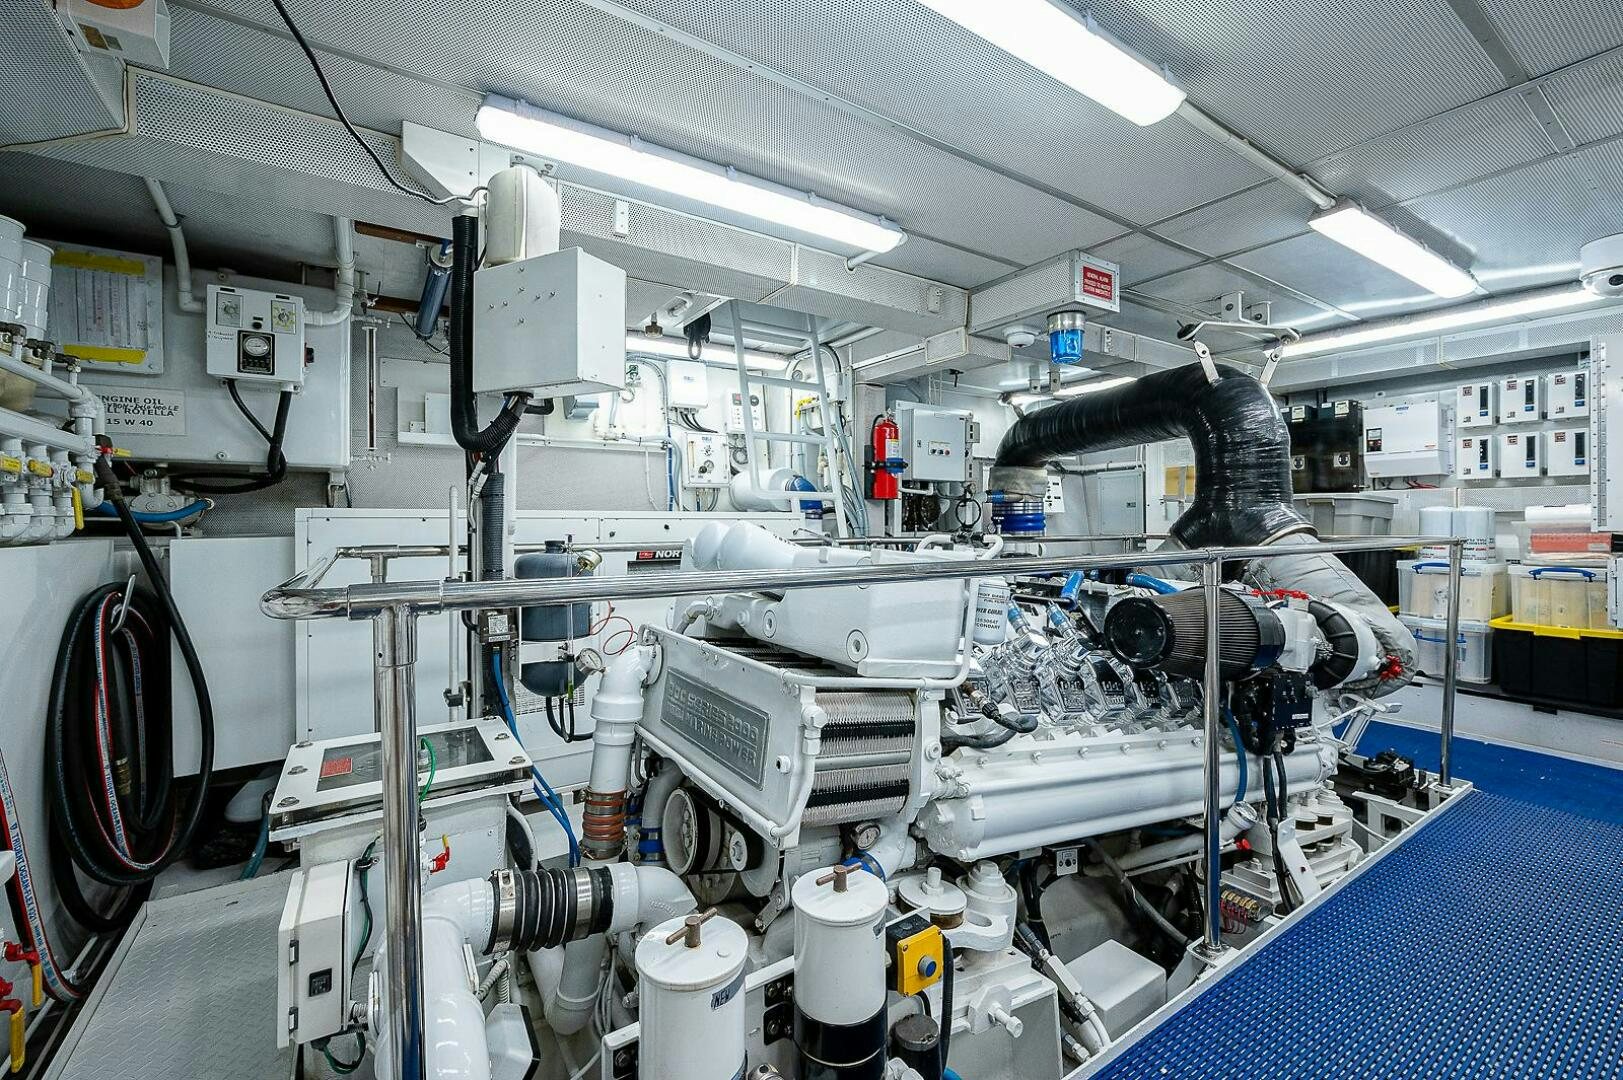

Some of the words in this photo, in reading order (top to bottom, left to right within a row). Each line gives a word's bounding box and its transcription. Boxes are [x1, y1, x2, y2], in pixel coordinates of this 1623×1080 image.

[99, 395, 140, 404] NGINE
[143, 397, 164, 406] OIL
[124, 409, 175, 417] ROTELLA
[139, 419, 154, 427] 40
[11, 832, 25, 865] TRIDENT
